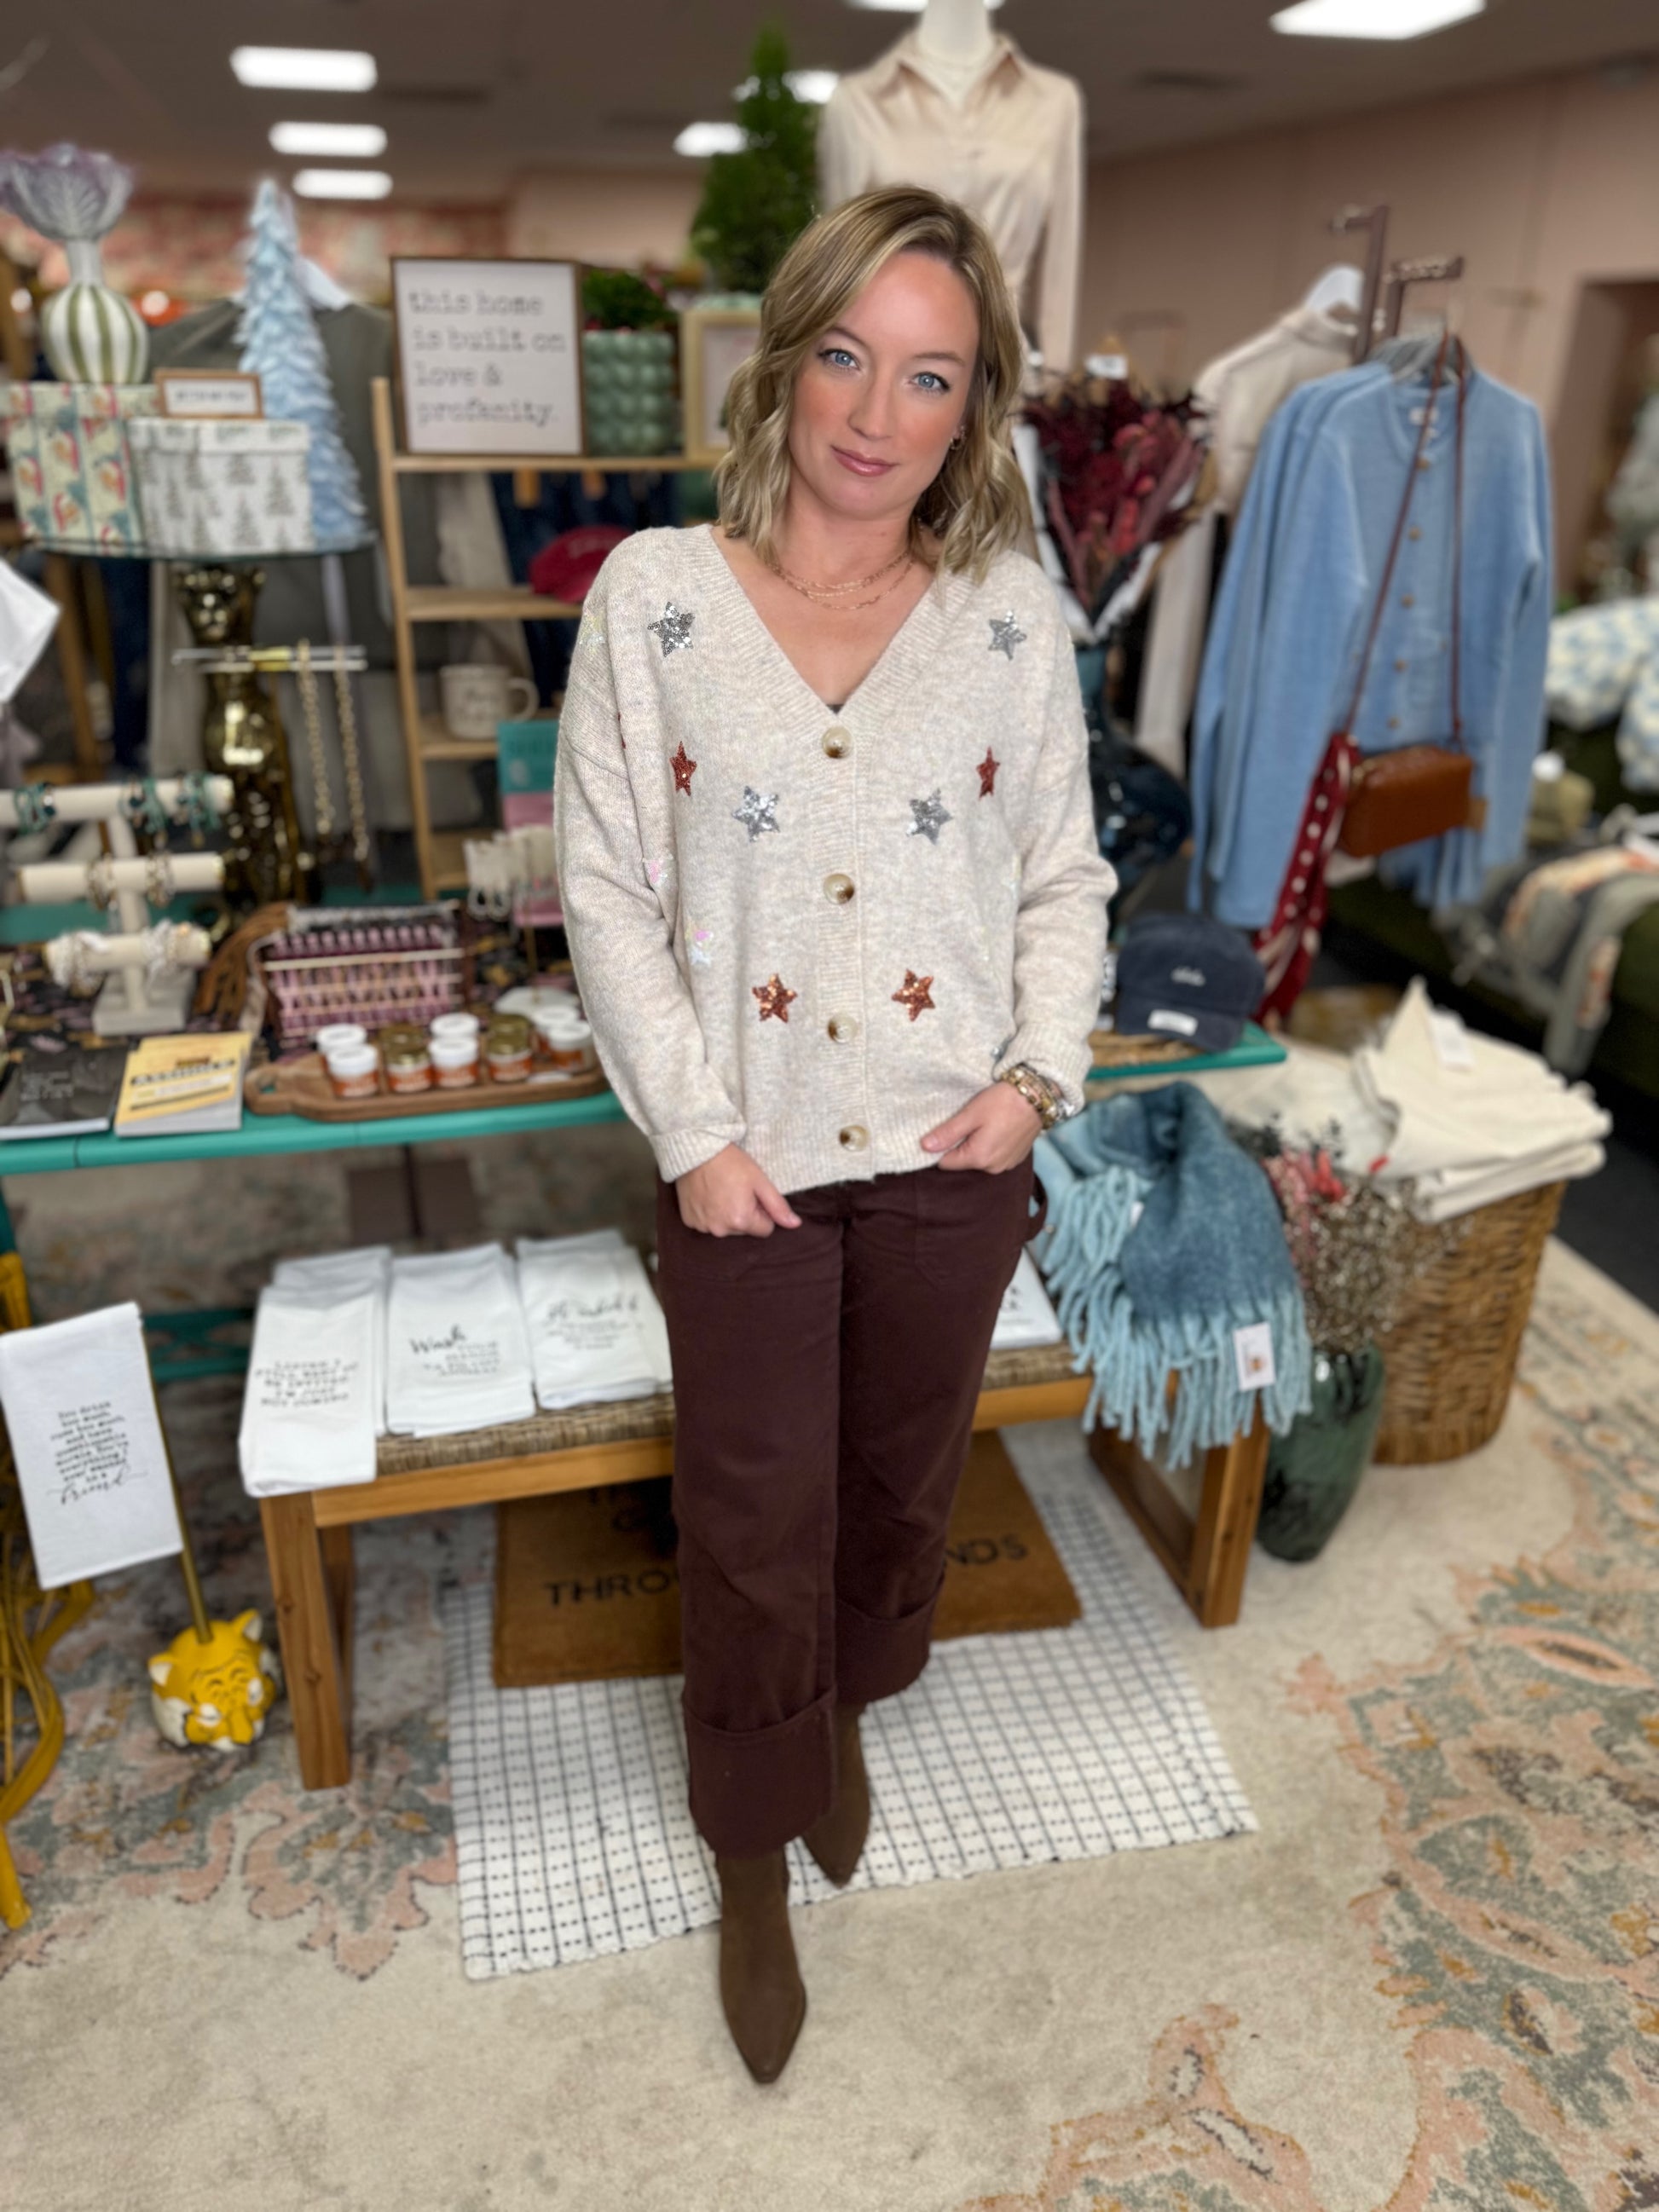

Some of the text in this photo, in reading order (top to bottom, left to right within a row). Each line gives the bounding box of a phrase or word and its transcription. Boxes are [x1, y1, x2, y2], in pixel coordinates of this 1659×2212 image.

[409, 290, 543, 315] this home
[413, 326, 566, 352] is built on
[416, 361, 502, 386] love &
[544, 1533, 1028, 1607] THRO NDS
